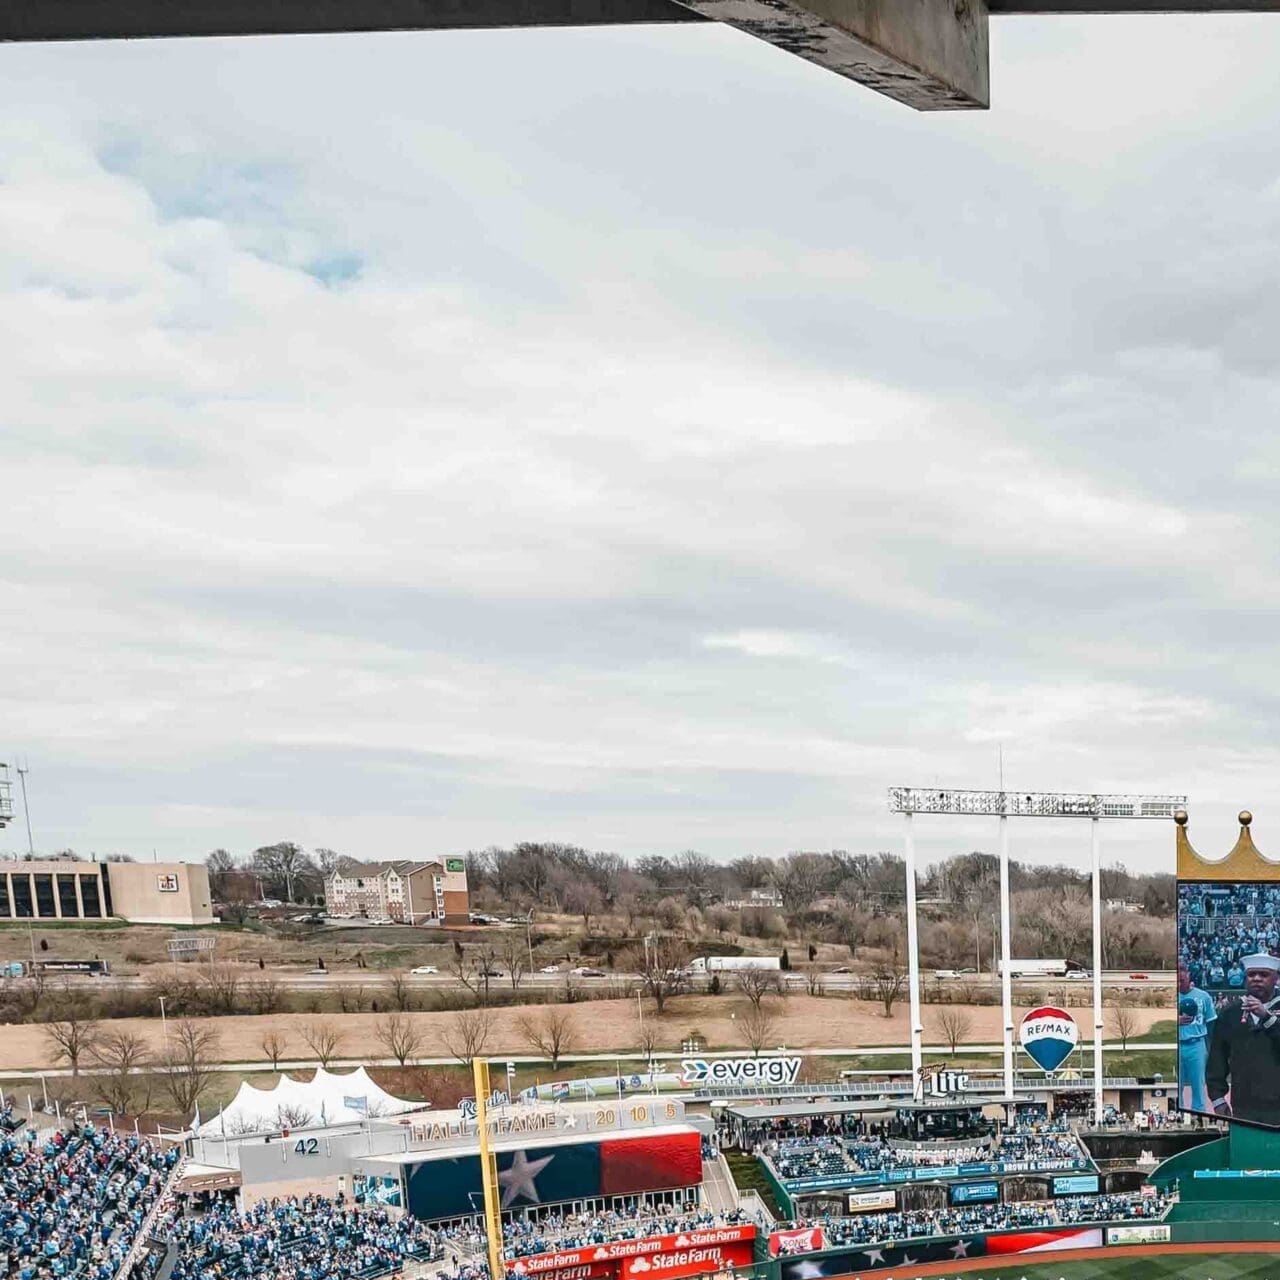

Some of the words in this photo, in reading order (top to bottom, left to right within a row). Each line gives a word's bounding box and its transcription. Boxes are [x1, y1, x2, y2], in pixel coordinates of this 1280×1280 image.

[1027, 1023, 1071, 1036] RE/MAX
[712, 1059, 800, 1083] evergy
[930, 1073, 969, 1098] Lite
[596, 1110, 615, 1125] 20
[630, 1106, 647, 1121] 10
[666, 1103, 675, 1118] 5
[411, 1121, 472, 1142] HALL
[498, 1111, 556, 1134] FAME
[294, 1138, 319, 1155] 42
[1003, 1163, 1029, 1172] BROWN
[783, 1238, 808, 1248] SONIC
